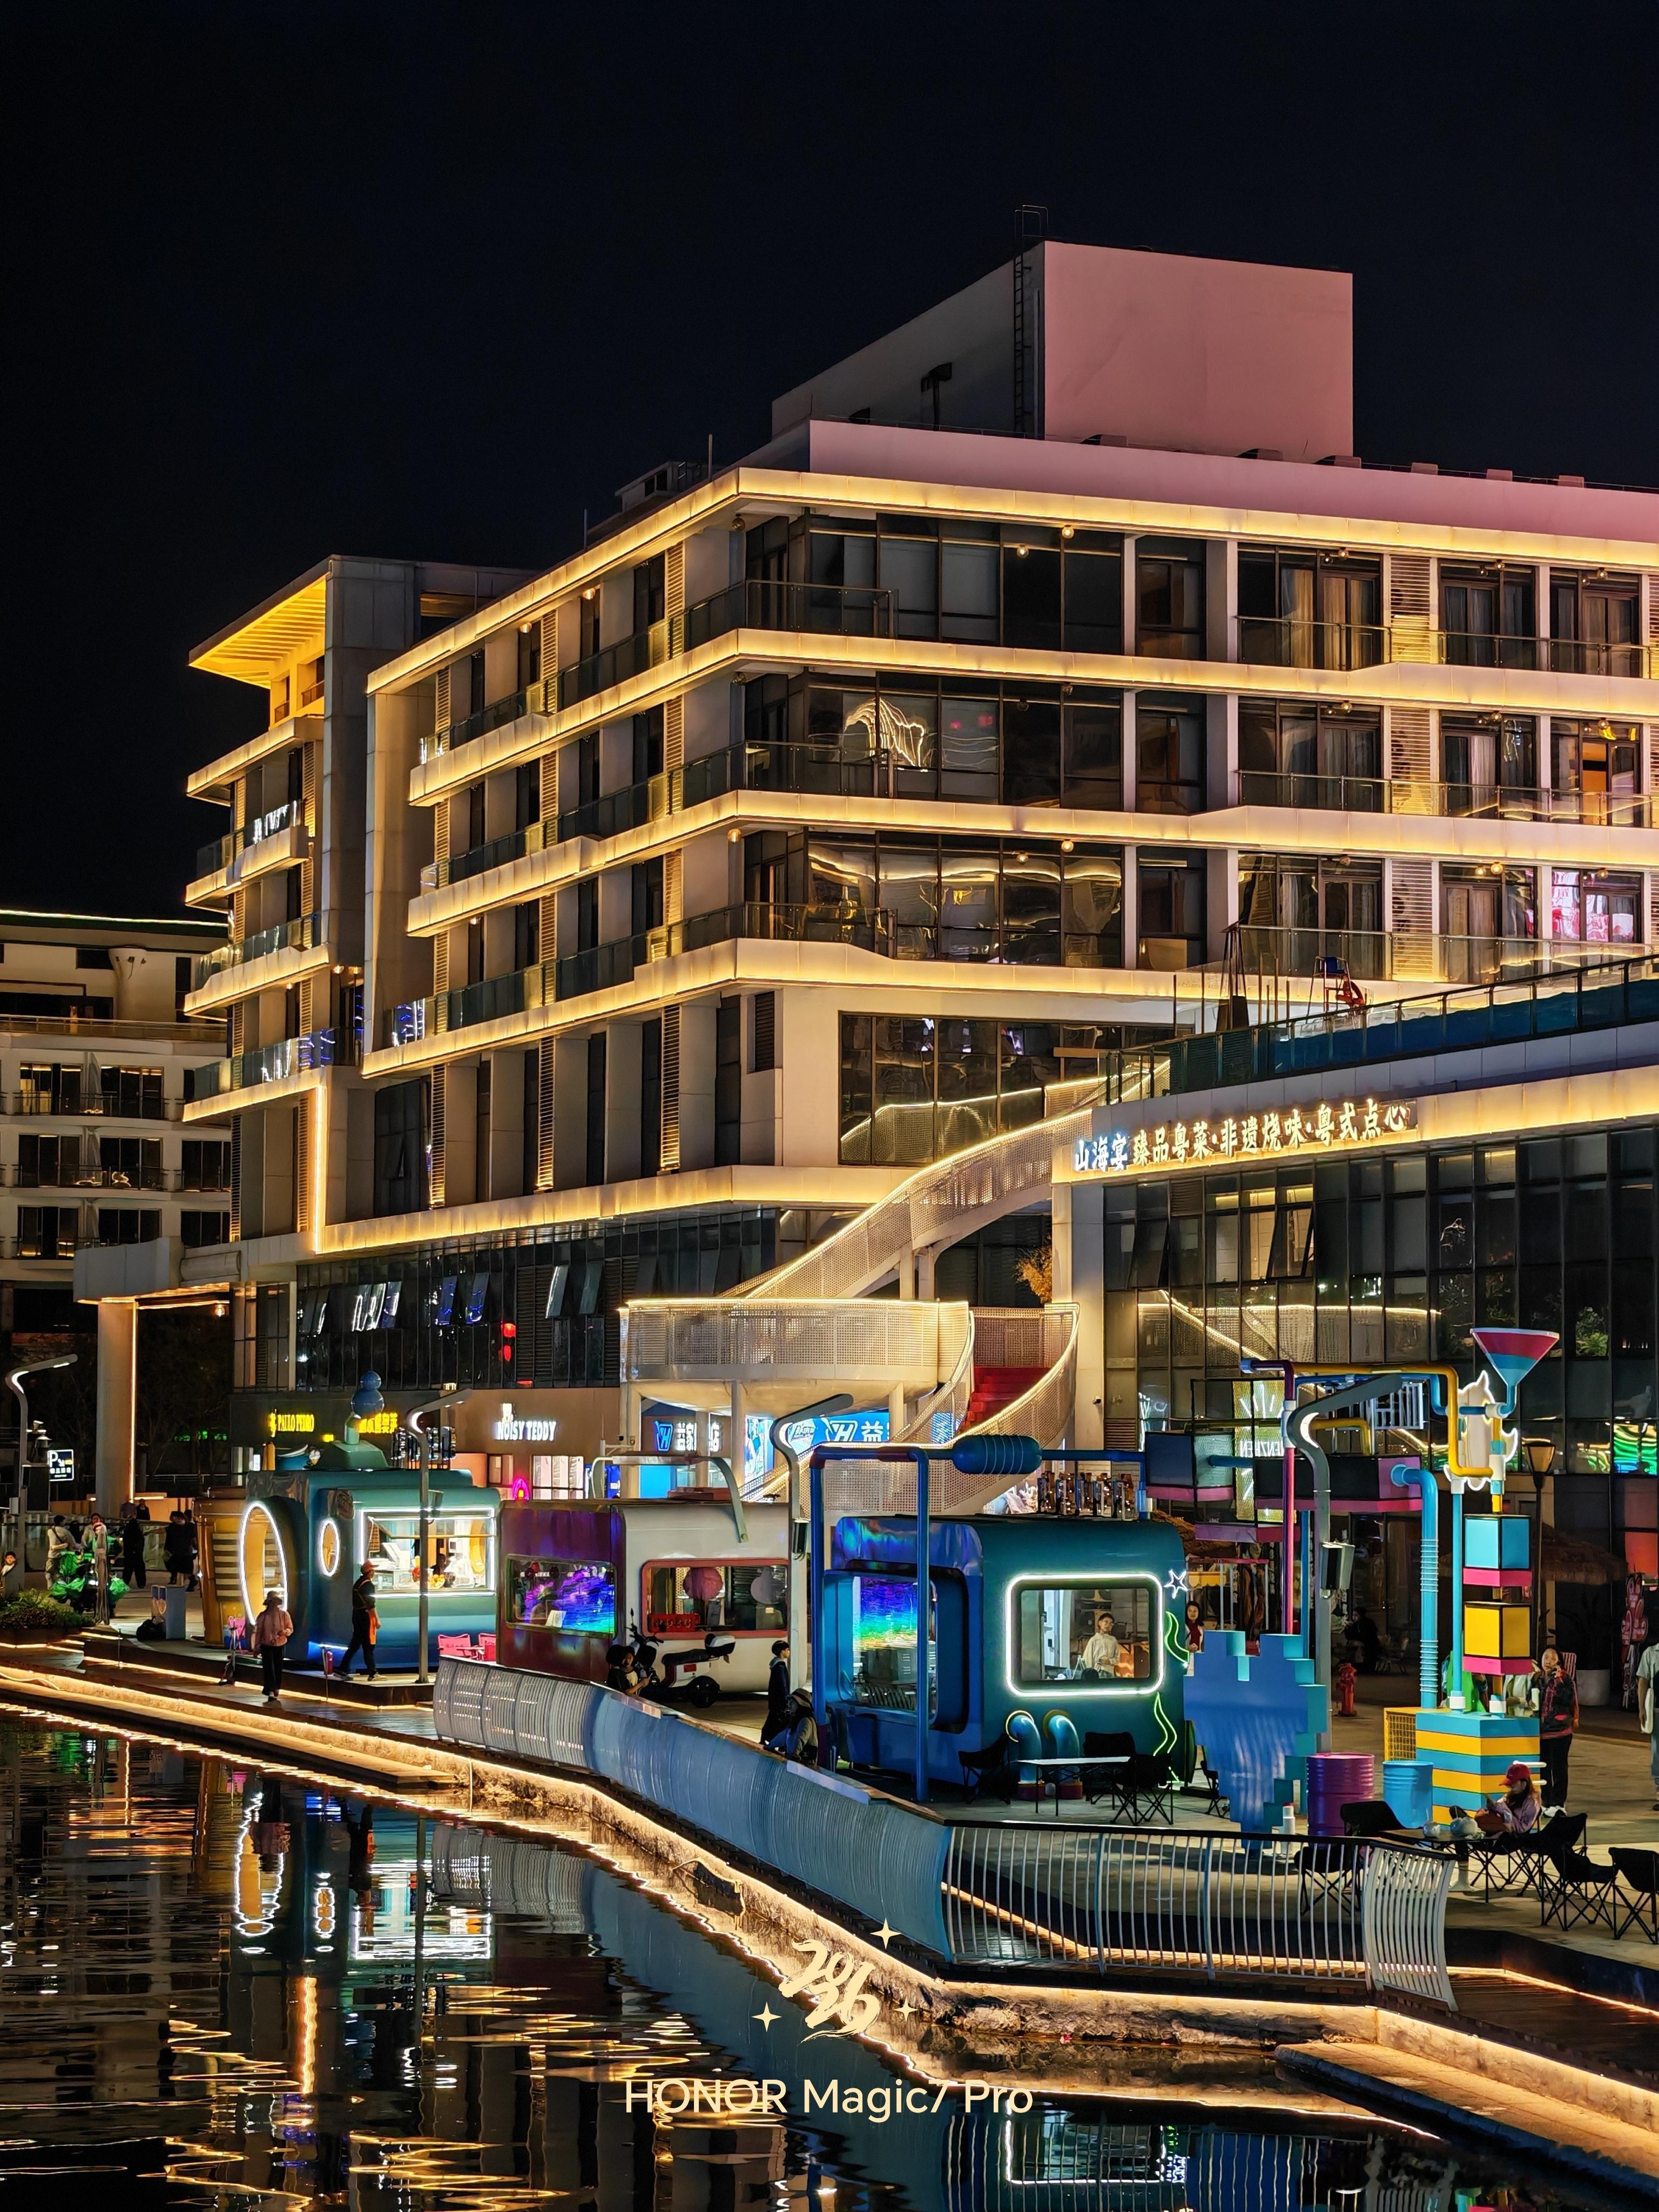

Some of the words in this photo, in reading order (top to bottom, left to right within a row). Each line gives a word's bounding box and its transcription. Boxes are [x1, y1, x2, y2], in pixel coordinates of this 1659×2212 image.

[1075, 1134, 1128, 1172] 山海宴
[497, 1421, 525, 1440] NOISY
[526, 1421, 556, 1441] TEDDY
[50, 1452, 58, 1467] P
